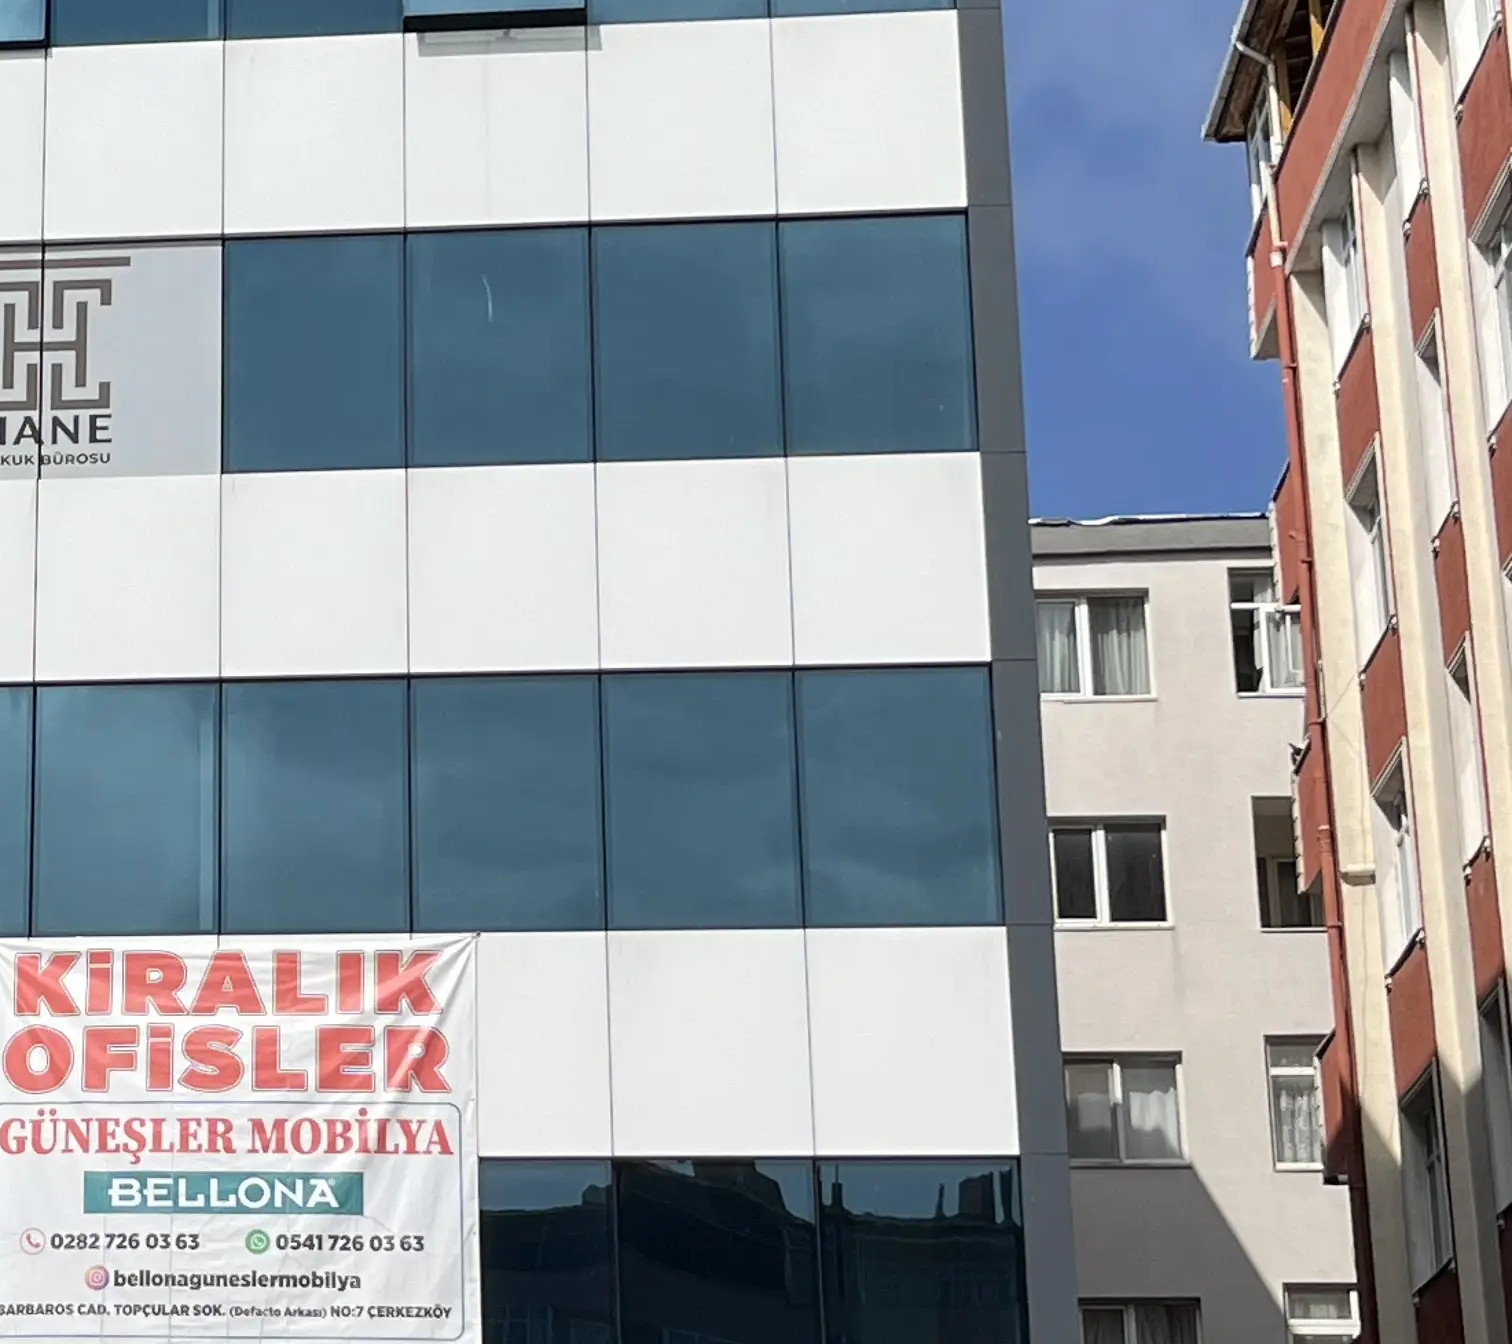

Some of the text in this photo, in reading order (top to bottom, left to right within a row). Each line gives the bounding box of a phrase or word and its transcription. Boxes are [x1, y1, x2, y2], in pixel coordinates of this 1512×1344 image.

[39, 451, 112, 467] BÜROSU
[13, 948, 446, 1016] KİRALIK
[1, 1022, 453, 1093] OFİSLER
[247, 1106, 455, 1156] MOBİLYA
[107, 1175, 340, 1210] BELLONA
[49, 1232, 200, 1251] 0282 726 03 63
[275, 1233, 425, 1252] 0541 726 03 63
[113, 1269, 362, 1292] bellonaguneslermobilya
[113, 1304, 190, 1319] TOPÇULAR
[193, 1304, 226, 1317] SOK.
[331, 1306, 364, 1318] NO:7
